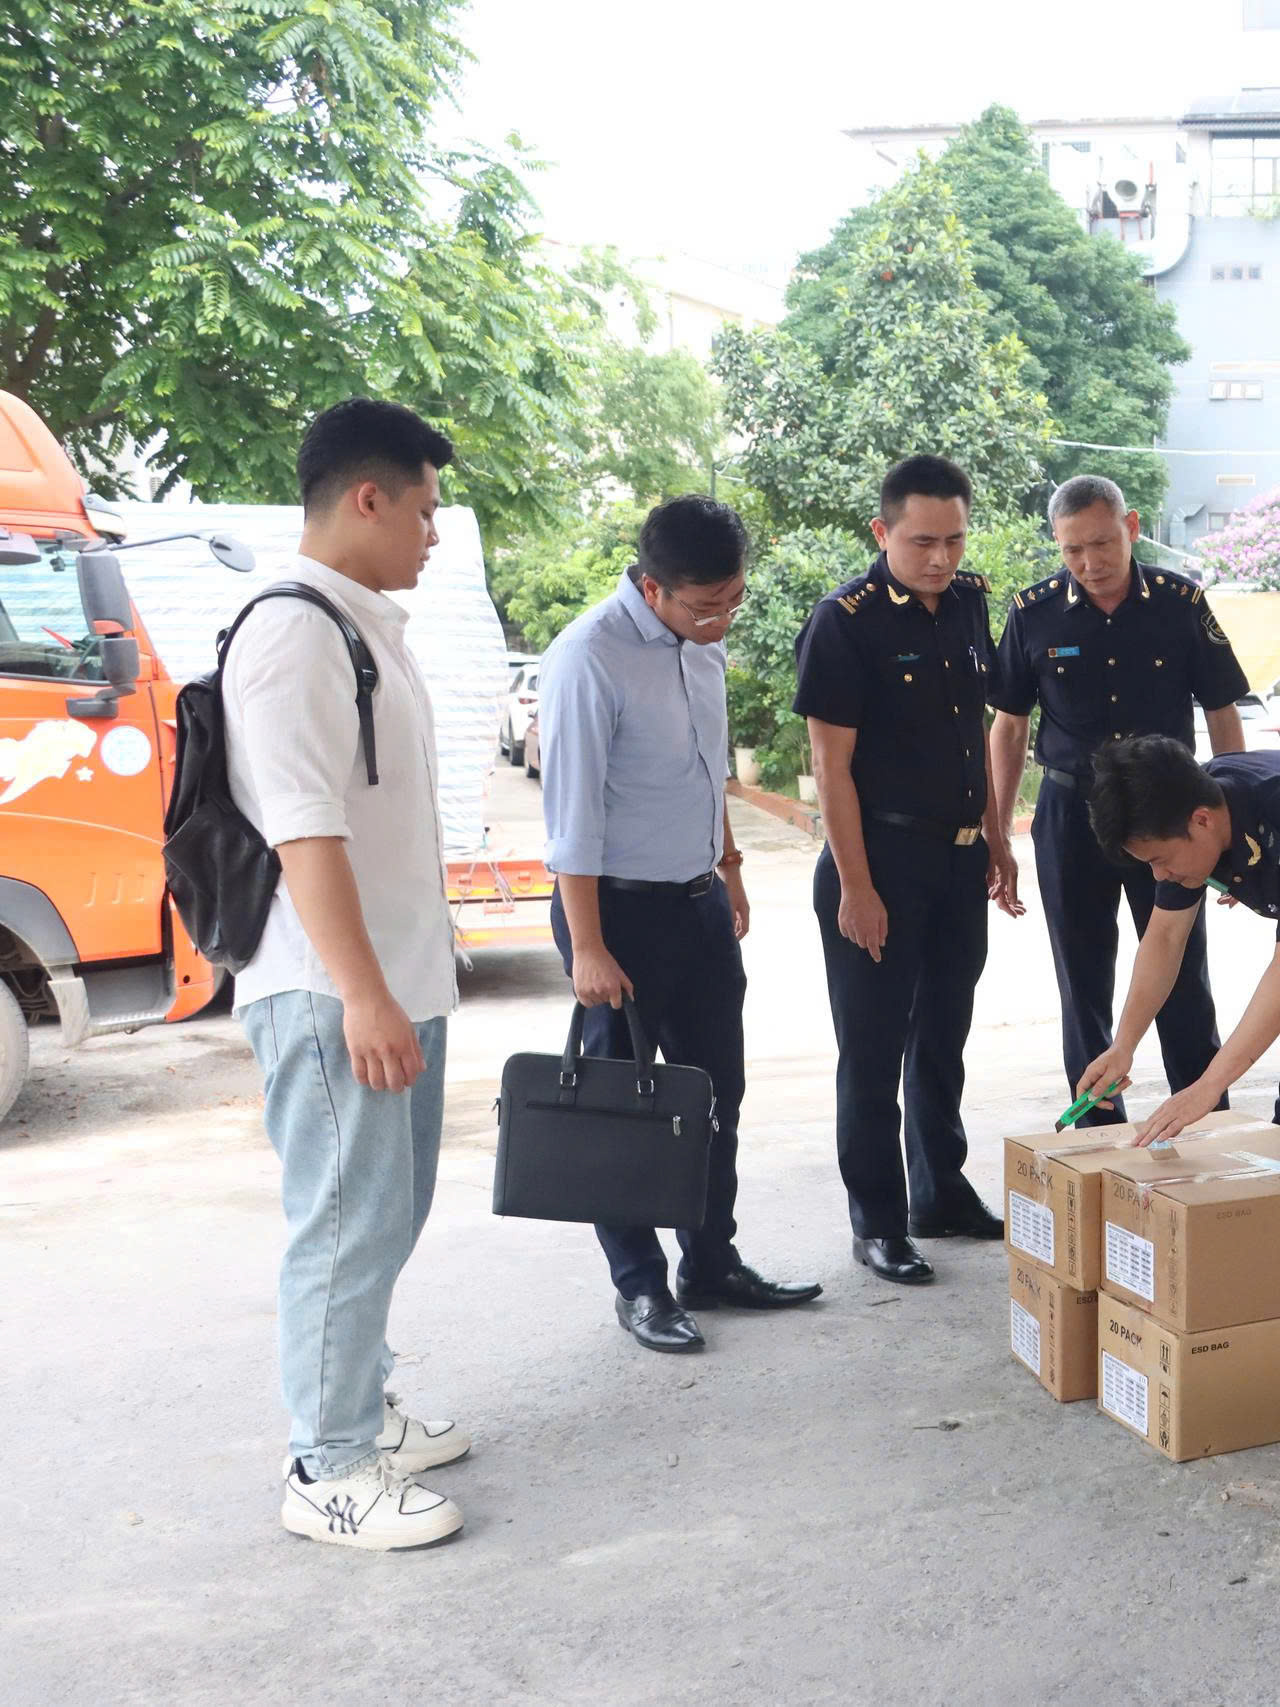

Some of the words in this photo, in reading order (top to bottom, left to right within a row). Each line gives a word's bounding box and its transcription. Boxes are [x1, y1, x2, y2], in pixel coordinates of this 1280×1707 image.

[1017, 1160, 1028, 1177] 20
[1113, 1182, 1125, 1200] 20
[1109, 1319, 1119, 1335] 20
[1120, 1325, 1142, 1350] PACK
[1191, 1345, 1209, 1354] ESD
[1210, 1341, 1230, 1351] BAG
[324, 1494, 359, 1536] NY
